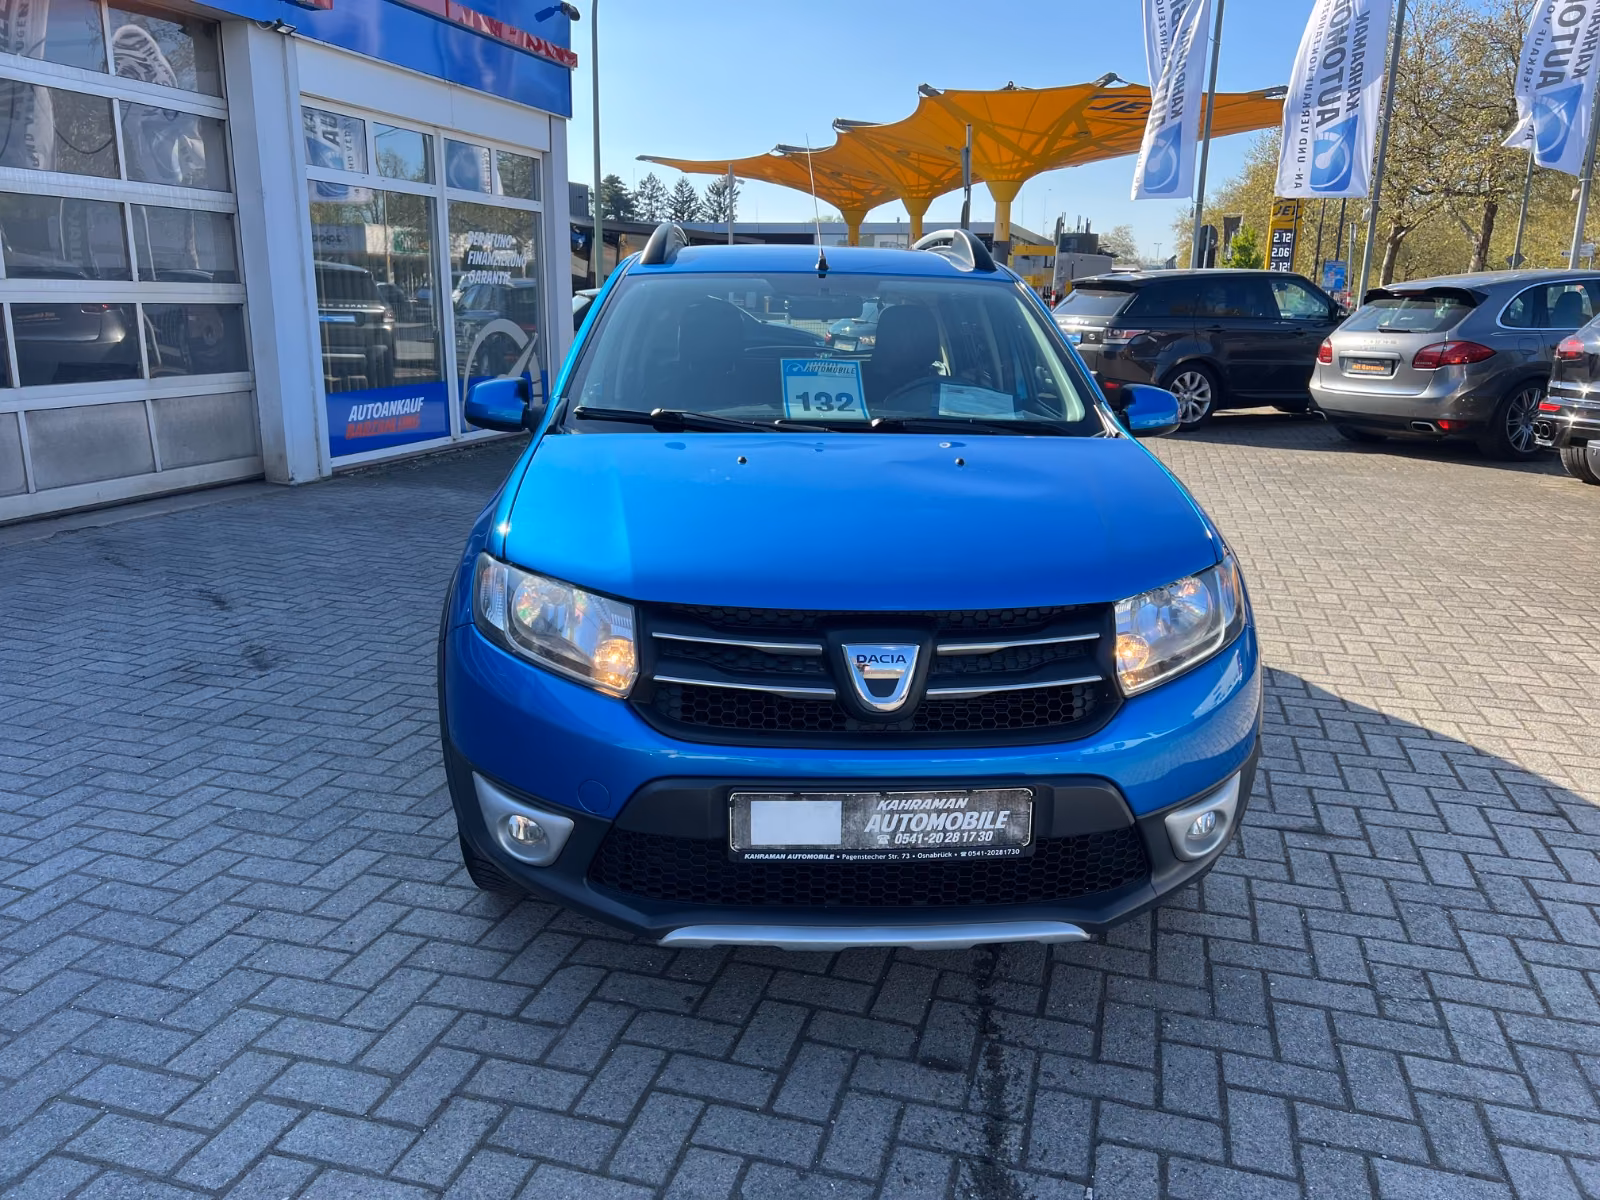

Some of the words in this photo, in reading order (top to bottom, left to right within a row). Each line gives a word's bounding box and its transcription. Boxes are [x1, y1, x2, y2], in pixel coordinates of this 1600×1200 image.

[1088, 100, 1152, 114] JE
[795, 391, 856, 412] 132
[347, 396, 425, 422] AUTOANKAUF
[856, 654, 907, 664] DACIA
[876, 797, 969, 811] KAHRAMAN
[863, 810, 1011, 833] AUTOMOBILE
[962, 831, 976, 842] 17
[977, 830, 994, 842] 30
[841, 853, 886, 862] Pagenstecher
[917, 850, 953, 859] Osnabrück
[967, 848, 1020, 857] 0541-20281730
